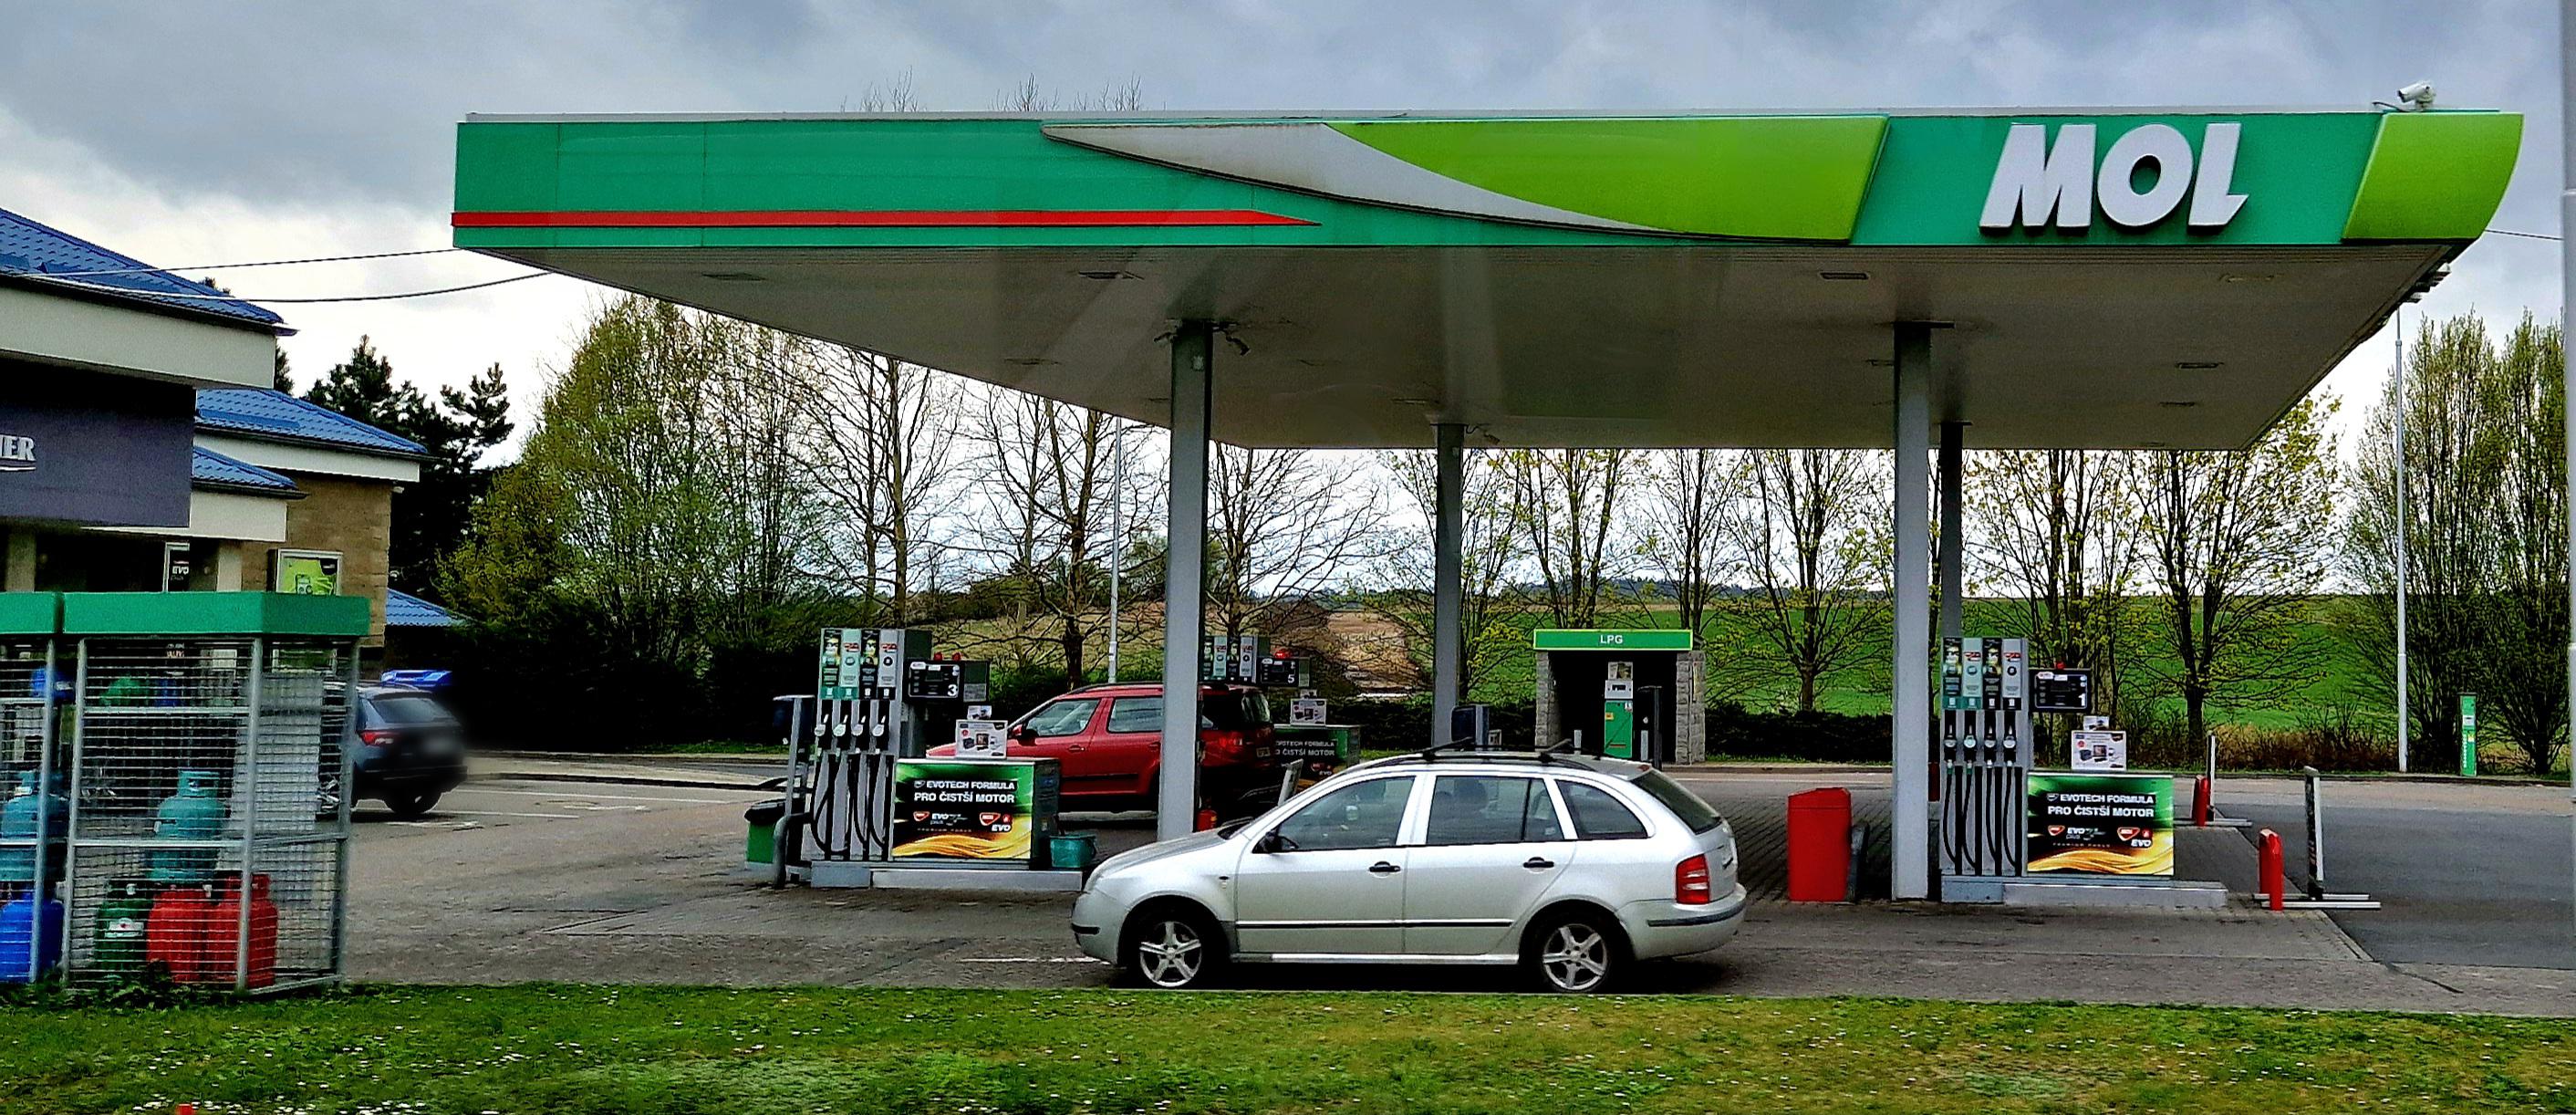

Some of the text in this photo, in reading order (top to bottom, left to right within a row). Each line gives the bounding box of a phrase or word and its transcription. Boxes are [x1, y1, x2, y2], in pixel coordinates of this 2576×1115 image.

[1979, 122, 2249, 229] MOL
[1600, 634, 1623, 644] LPG
[1287, 673, 1295, 683] 5
[947, 683, 958, 696] 3
[2078, 693, 2085, 706] 1
[926, 780, 1015, 790] EVOTECH FORMULA
[914, 790, 1015, 803] PRO ČISTŠÍ MOTOR
[2060, 793, 2154, 804] EVOTECH FORMULA
[2047, 805, 2155, 818] PRO ČISTŠÍ MOTOR
[992, 824, 1012, 832] EVO
